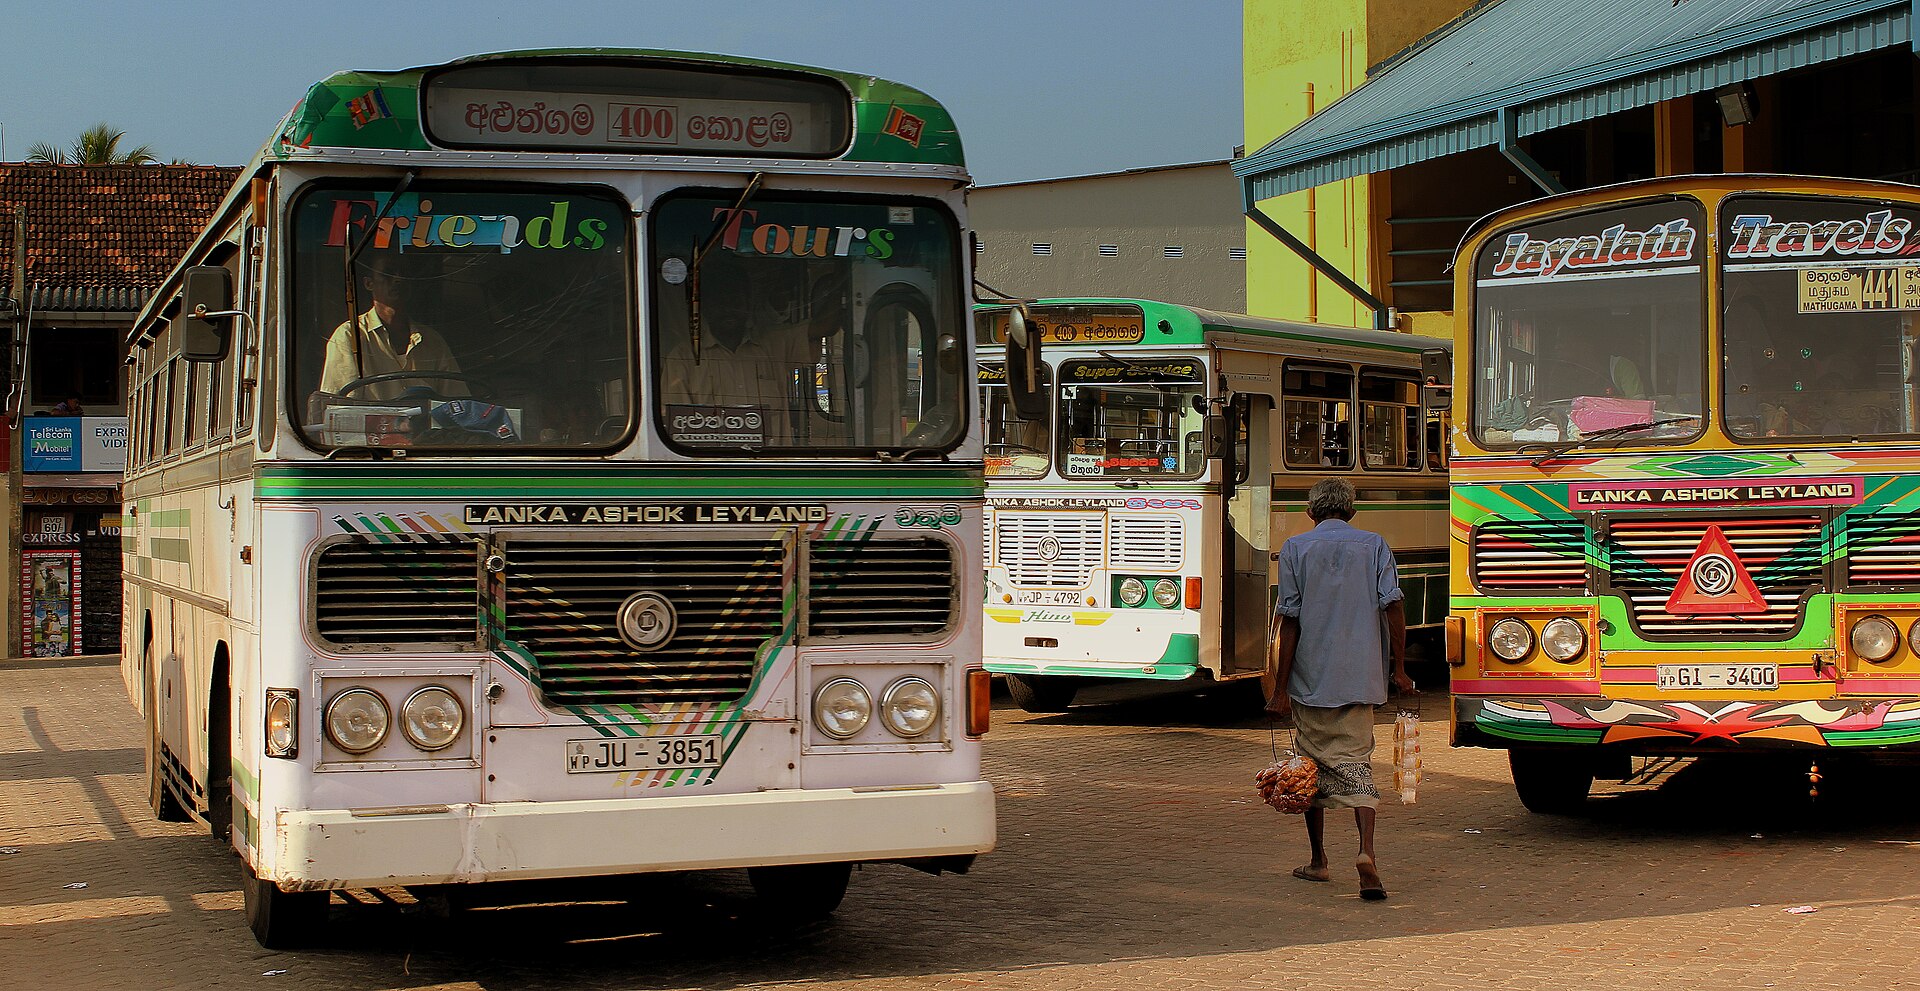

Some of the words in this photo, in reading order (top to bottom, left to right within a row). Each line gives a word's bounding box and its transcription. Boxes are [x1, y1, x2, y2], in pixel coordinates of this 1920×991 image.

[465, 101, 595, 136] අළුත්ගම
[612, 107, 673, 138] 400
[687, 112, 793, 147] කොළඹ
[324, 199, 607, 250] Friends
[712, 207, 894, 260] Tours
[1726, 209, 1912, 259] Travels
[1492, 216, 1698, 277] Jayalath
[1862, 269, 1897, 308] 441
[1803, 301, 1857, 311] MATHUGAMA
[1056, 326, 1073, 340] 408
[1074, 365, 1124, 379] Super
[30, 428, 72, 438] Telecom
[34, 442, 69, 453] Mobitel
[983, 498, 1020, 506] ANKA
[1069, 499, 1126, 507] LEYLAND
[1577, 490, 1651, 503] LANKA
[1661, 488, 1739, 501] ASHOK
[1748, 484, 1853, 499] LEYLAND
[466, 506, 568, 524] LANKA
[581, 505, 684, 522] ASHOK
[695, 505, 826, 522] LEYLAND
[22, 533, 80, 543] EXPRESS
[1053, 592, 1080, 604] 4792
[1726, 667, 1775, 686] 3400
[595, 743, 627, 768] JU
[656, 739, 718, 765] 3851
